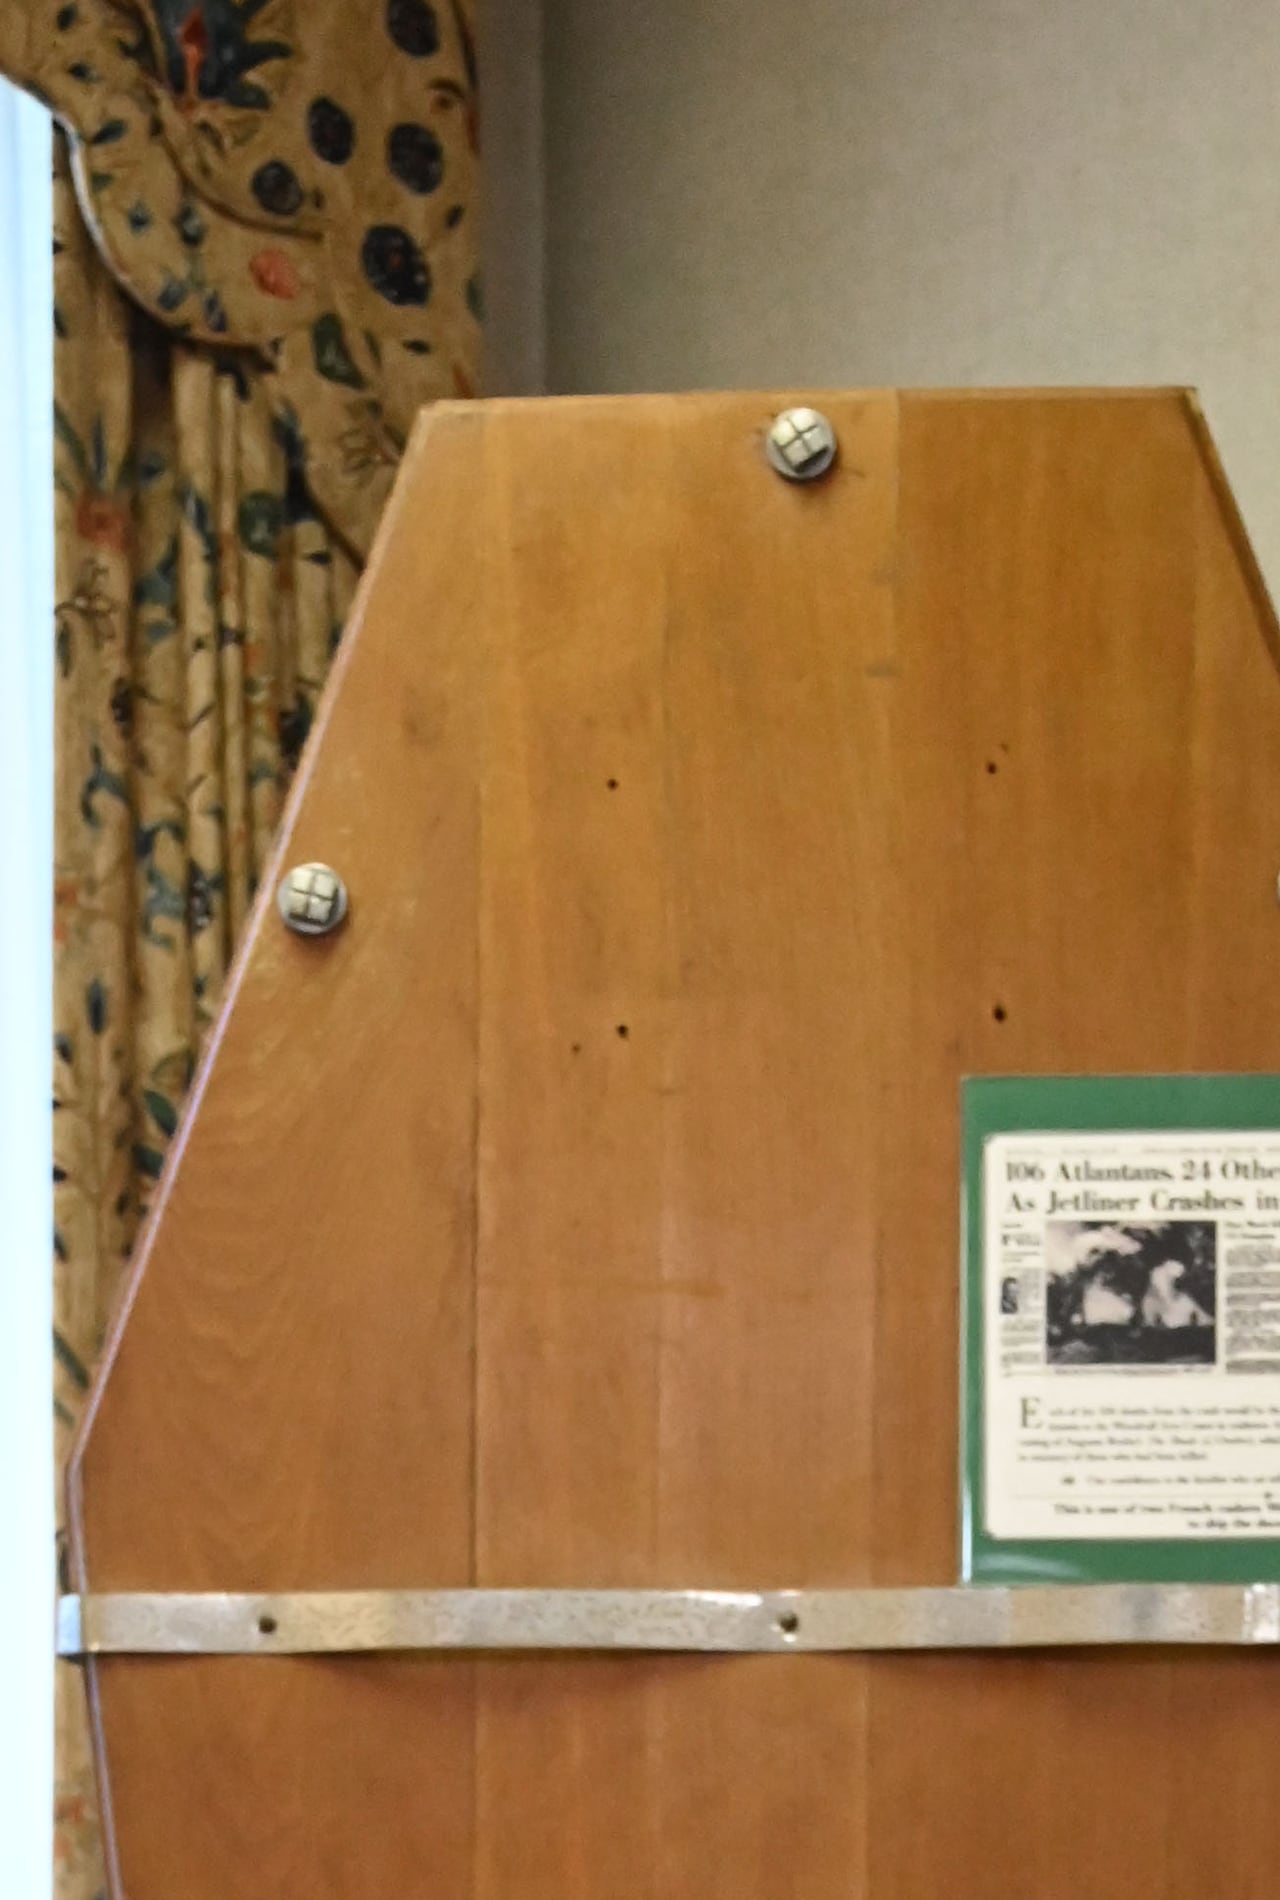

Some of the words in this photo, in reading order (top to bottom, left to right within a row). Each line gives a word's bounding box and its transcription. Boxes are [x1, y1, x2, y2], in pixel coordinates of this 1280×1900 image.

[1006, 1162, 1045, 1182] 106
[1181, 1159, 1212, 1182] 24
[1006, 1191, 1034, 1212] As
[1046, 1190, 1139, 1214] Jetliner
[1150, 1191, 1244, 1211] Crashes
[1256, 1190, 1280, 1210] in
